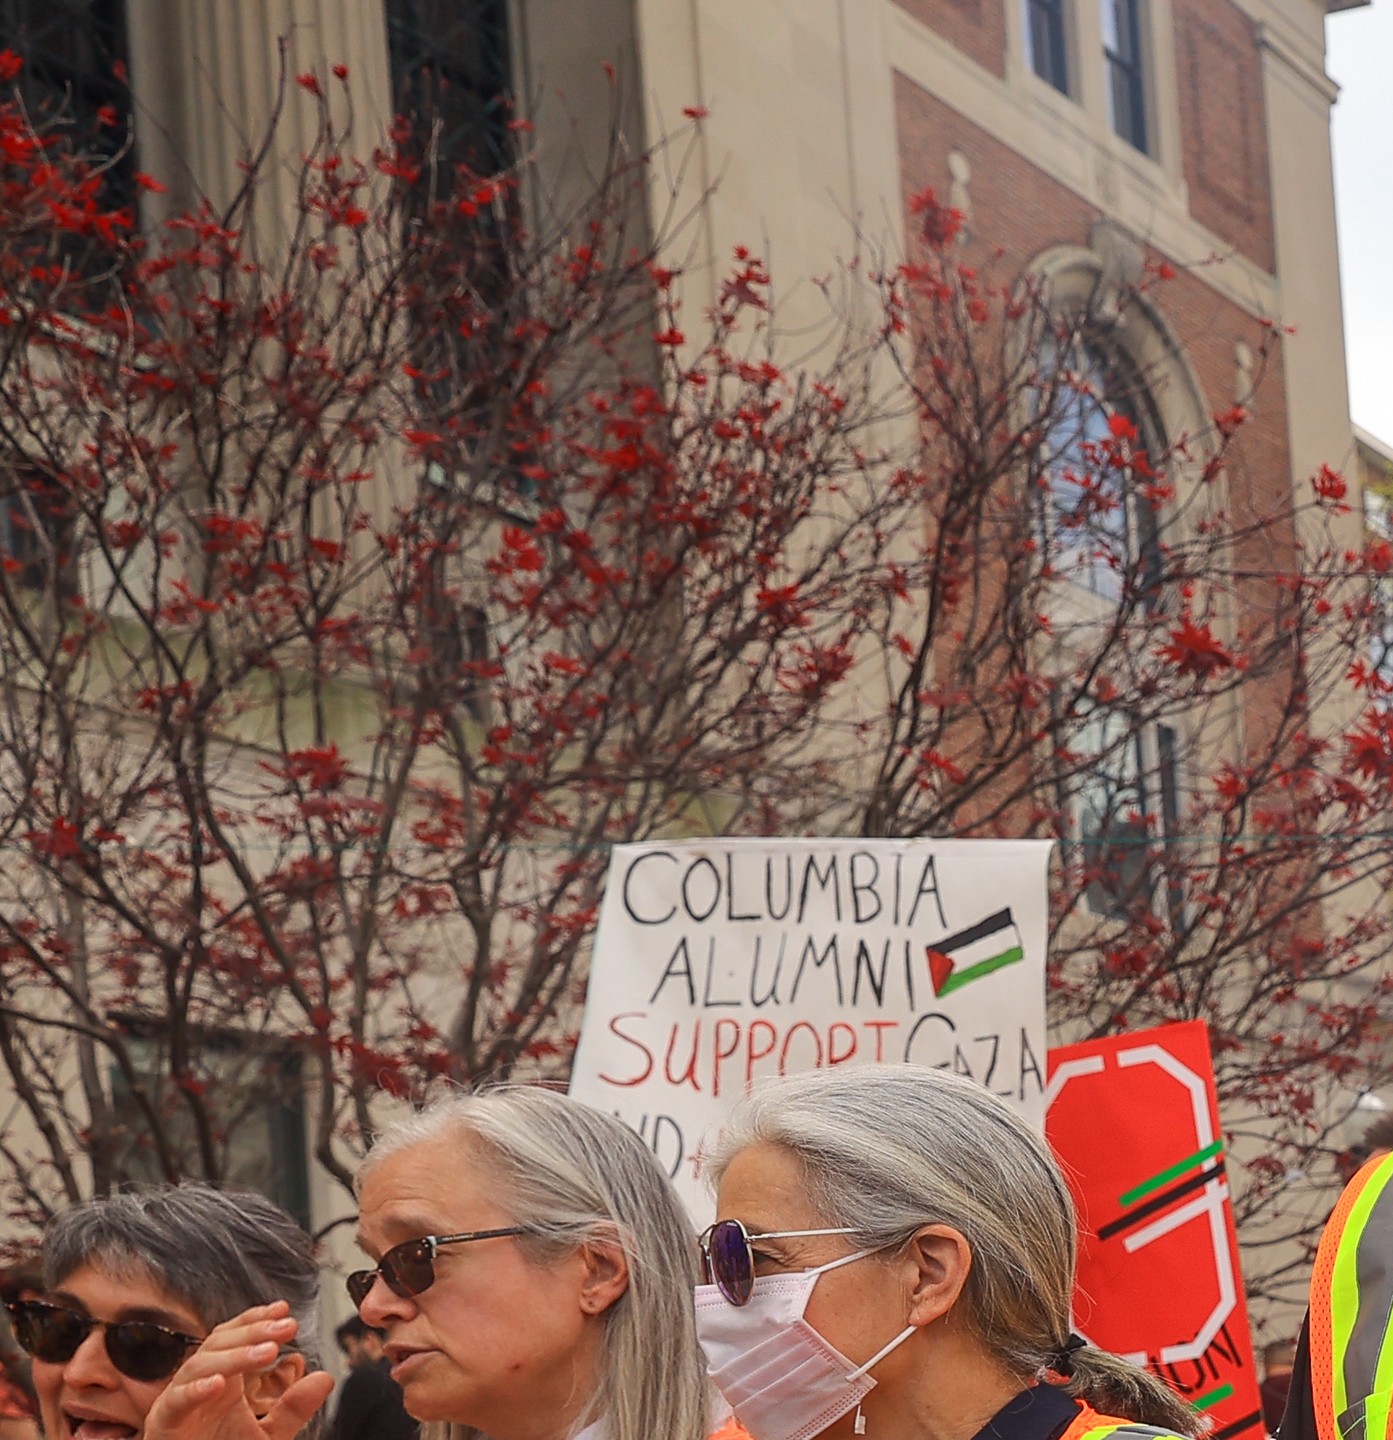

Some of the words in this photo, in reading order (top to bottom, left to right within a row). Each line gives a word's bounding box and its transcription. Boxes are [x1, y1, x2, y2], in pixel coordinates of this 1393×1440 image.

[621, 850, 949, 930] COLUMBIA
[649, 934, 916, 1012] ALUMNI
[598, 1011, 899, 1097] SUPPORT
[904, 1012, 1044, 1101] GAZA
